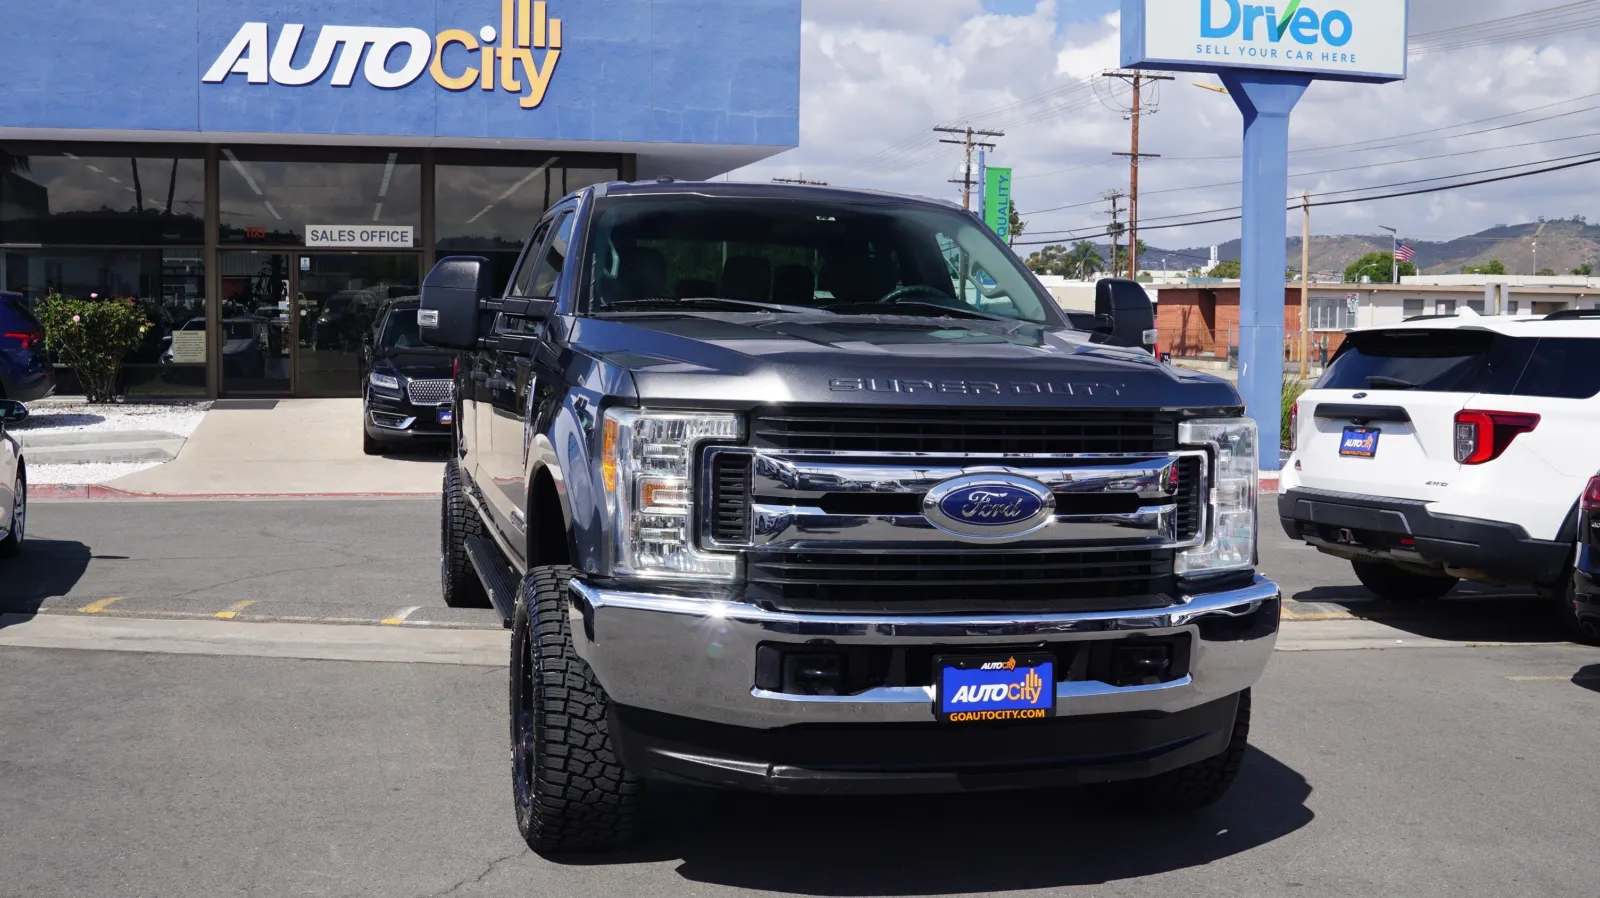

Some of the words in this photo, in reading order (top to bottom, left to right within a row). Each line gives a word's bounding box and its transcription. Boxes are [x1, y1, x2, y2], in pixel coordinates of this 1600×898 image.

[1200, 0, 1353, 48] Driveo
[1196, 44, 1230, 55] SELL
[1238, 47, 1278, 58] YOUR
[1286, 50, 1313, 60] CAR
[1321, 52, 1356, 63] HERE
[310, 229, 356, 242] SALES
[359, 230, 409, 243] OFFICE
[828, 378, 1001, 395] SUPER
[1009, 380, 1126, 397] DUTY
[961, 490, 1023, 518] Ford
[951, 668, 1043, 704] AUTOCity
[949, 709, 1046, 722] GOAUTOCITY.COM
